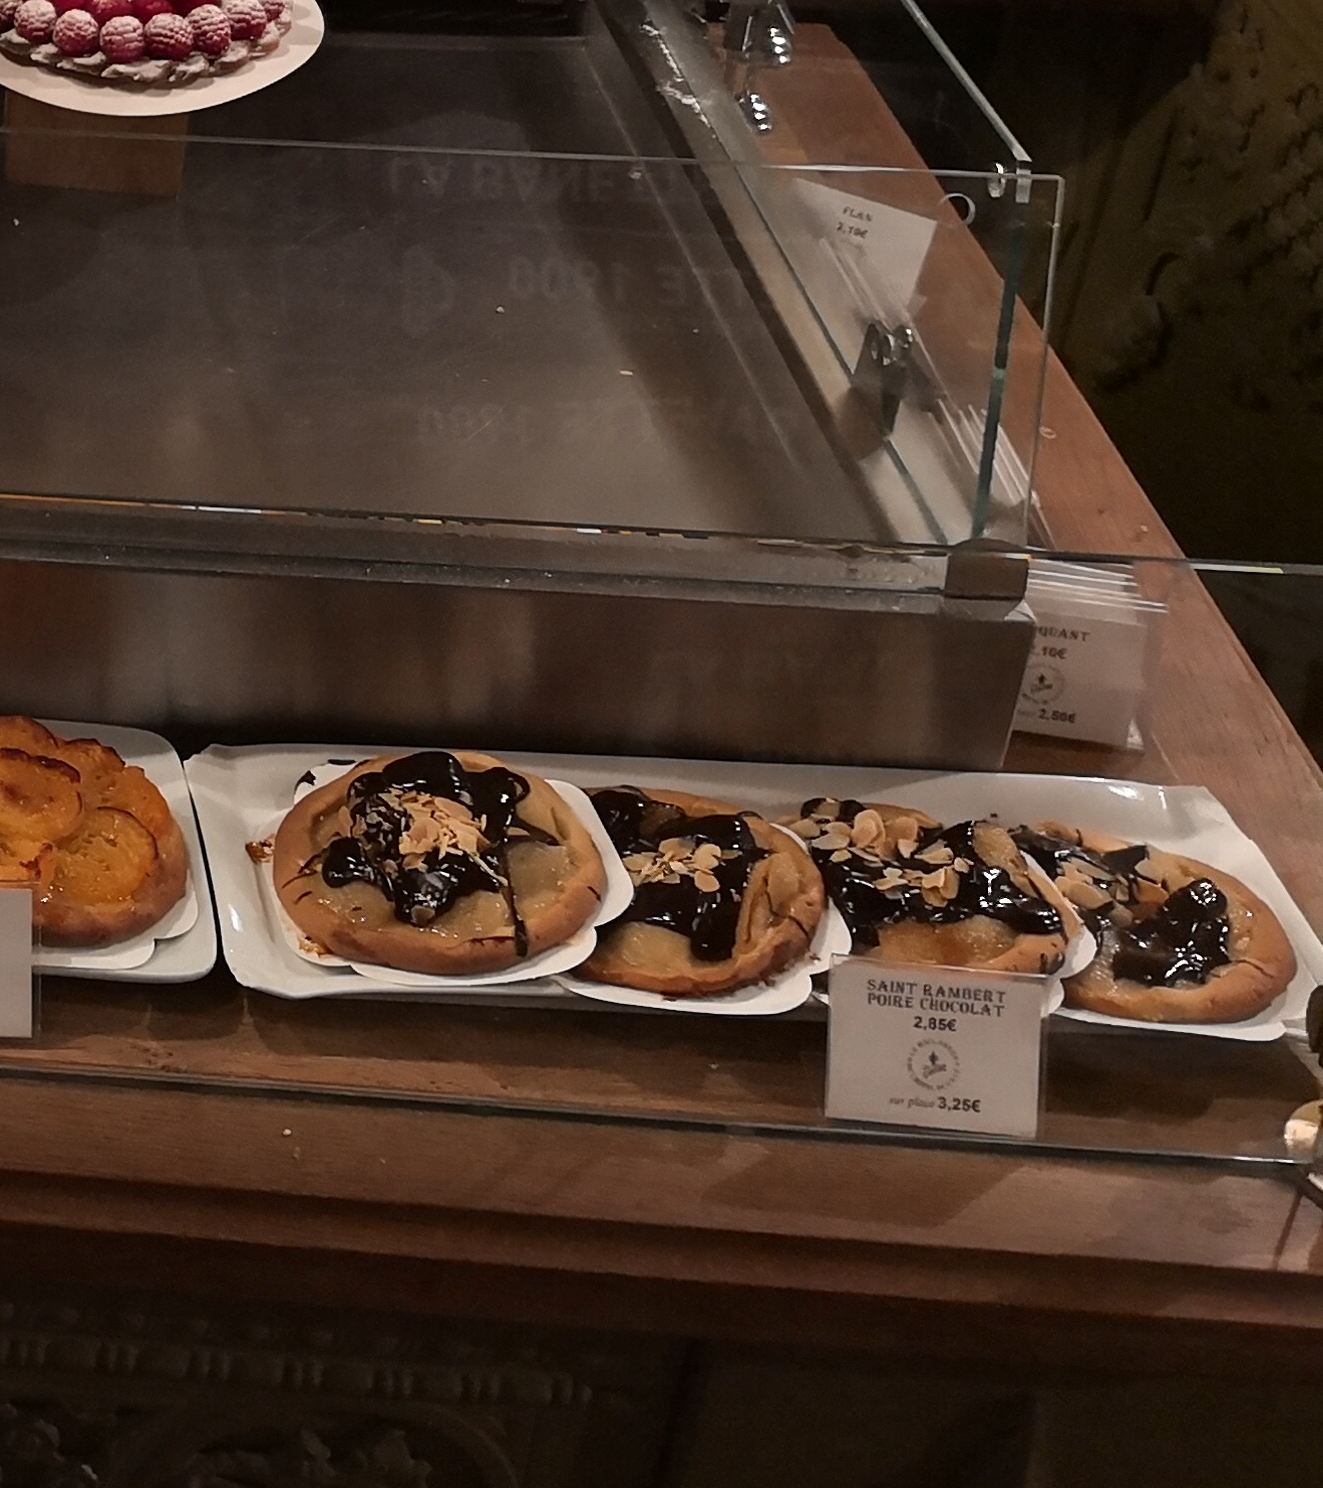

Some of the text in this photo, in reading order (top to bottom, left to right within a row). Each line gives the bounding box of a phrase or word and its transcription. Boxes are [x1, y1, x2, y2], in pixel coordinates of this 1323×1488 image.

[1037, 625, 1091, 642] QUANT
[1036, 646, 1067, 660] ,10€
[867, 978, 1006, 1004] SAINT RAMBERT
[867, 992, 1005, 1018] POIRE CHOCOLAT
[913, 1015, 957, 1032] 2,85€
[937, 1096, 981, 1113] 3,25€
